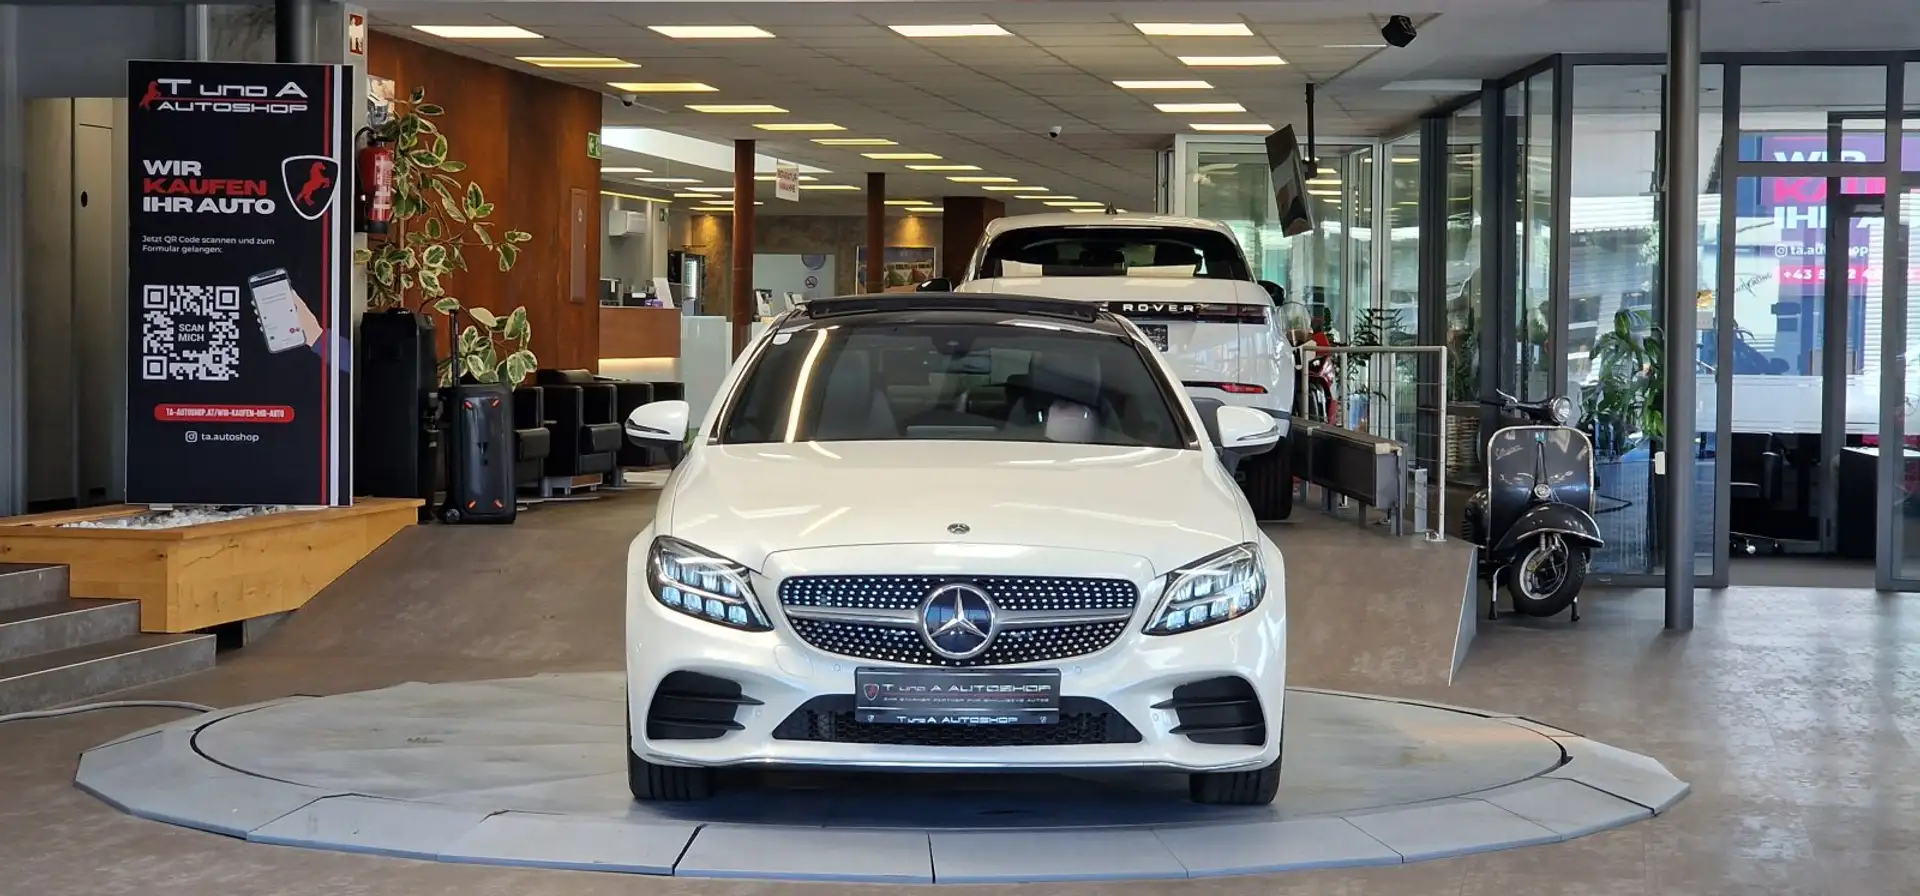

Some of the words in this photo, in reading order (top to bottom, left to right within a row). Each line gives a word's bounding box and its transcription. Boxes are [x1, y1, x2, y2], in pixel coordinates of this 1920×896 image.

[157, 78, 192, 95] T
[275, 81, 308, 98] A
[157, 101, 308, 114] AUTOSHOP
[143, 159, 201, 176] WIR
[143, 178, 267, 196] KAUFEN
[143, 197, 193, 213] IHR
[196, 197, 276, 214] AUTO
[142, 235, 162, 243] Jetzt
[163, 235, 177, 244] QR
[178, 236, 201, 244] Code
[202, 236, 237, 245] scannen
[238, 236, 255, 245] und
[142, 244, 180, 252] Formular
[181, 245, 223, 255] gelangen:
[1122, 303, 1194, 312] ROVER
[178, 323, 204, 333] SCAN
[178, 333, 204, 342] MICH
[201, 432, 260, 443] ta.autoshop
[882, 683, 894, 691] T
[930, 684, 941, 692] A
[948, 684, 1052, 692] AUTOSHOP
[941, 716, 1018, 724] AUTOSHOP
